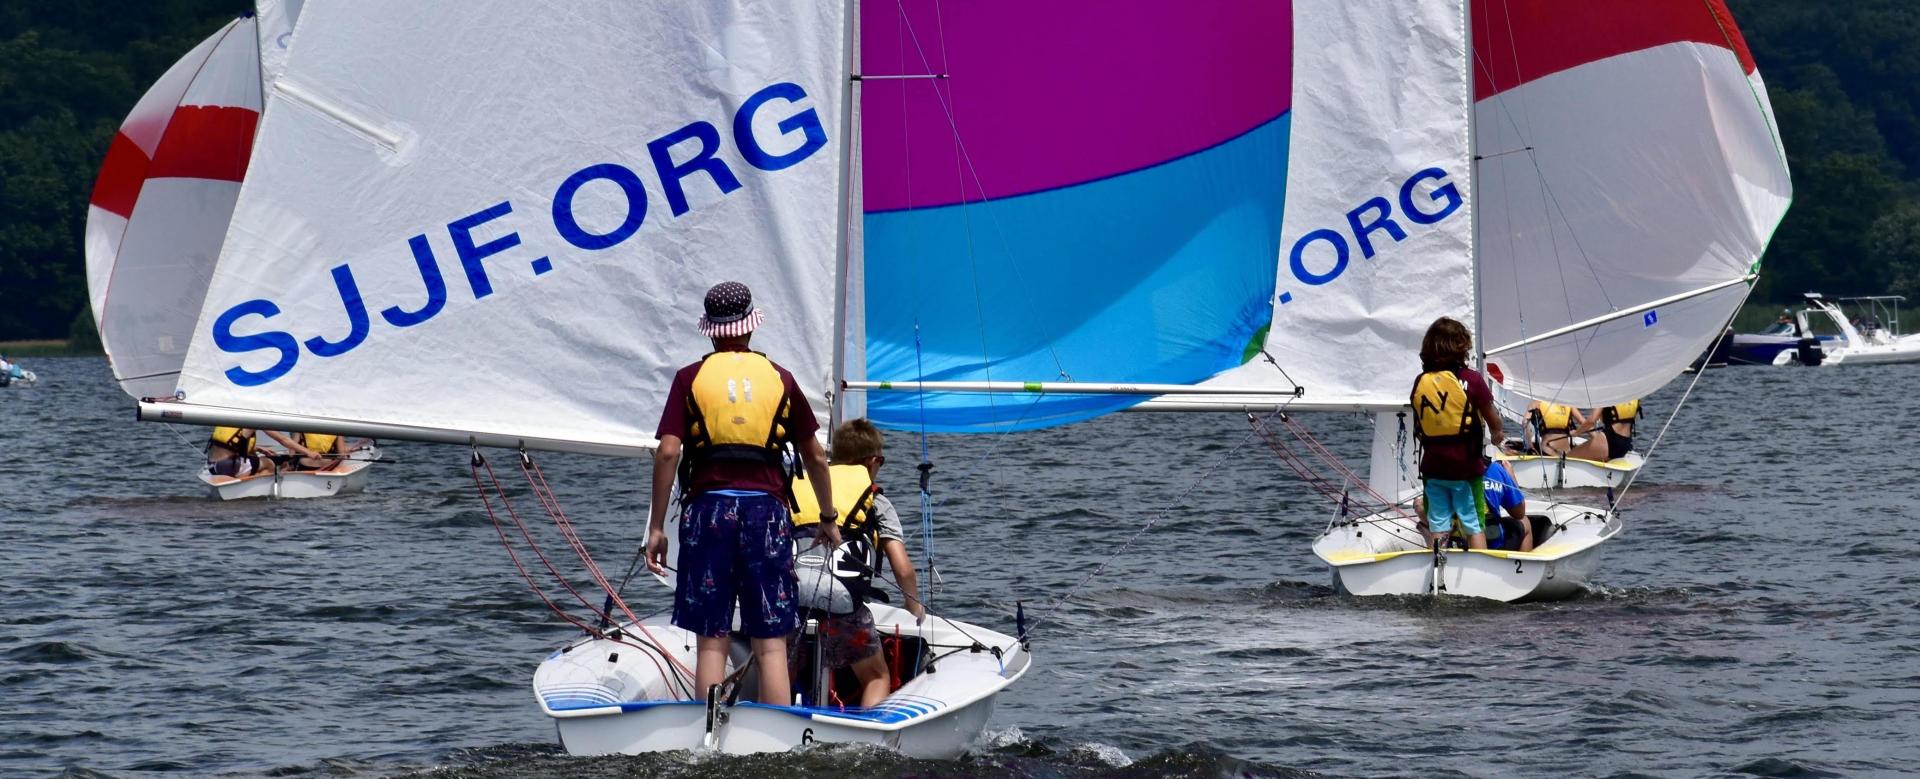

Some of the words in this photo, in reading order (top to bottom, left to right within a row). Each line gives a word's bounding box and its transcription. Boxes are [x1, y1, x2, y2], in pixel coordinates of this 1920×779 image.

[212, 82, 828, 387] SJJF.ORG
[327, 480, 332, 489] 5
[1483, 480, 1503, 492] EAM
[1515, 559, 1523, 573] 2
[802, 727, 814, 745] 6
